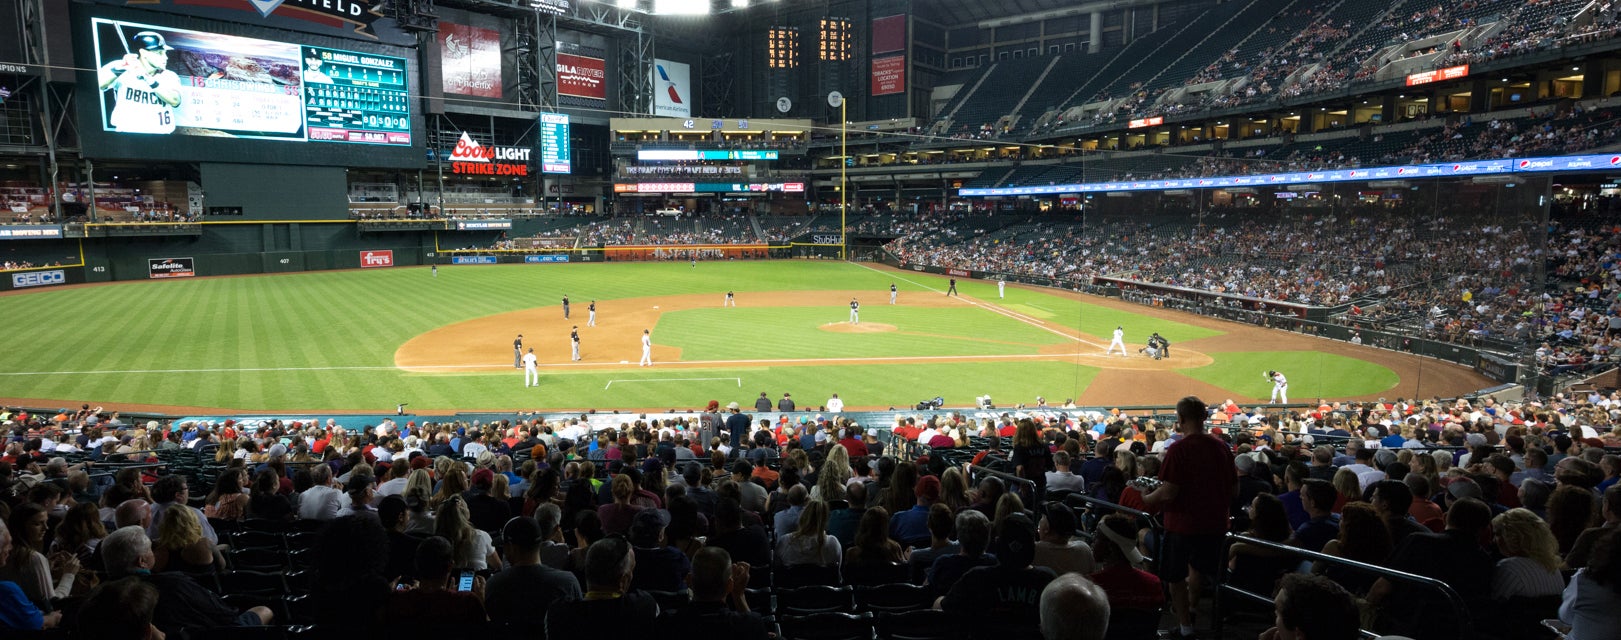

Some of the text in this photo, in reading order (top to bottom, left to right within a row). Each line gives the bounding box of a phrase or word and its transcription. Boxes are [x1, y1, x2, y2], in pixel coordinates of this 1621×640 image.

[333, 54, 359, 63] MIGUEL
[361, 57, 394, 67] GONZALEZ
[576, 66, 604, 78] RIVER
[190, 76, 205, 88] 16
[458, 76, 491, 90] Phoenix
[158, 110, 170, 125] 16
[370, 116, 376, 125] 0
[385, 117, 391, 126] 0
[400, 118, 406, 127] 0
[684, 120, 694, 128] 42
[452, 139, 531, 161] Coors LIGHT
[452, 162, 527, 176] STRIKE ZONE
[364, 252, 390, 265] fry's
[14, 270, 64, 287] GEICO
[703, 421, 712, 432] 21
[997, 586, 1037, 604] LAMB
